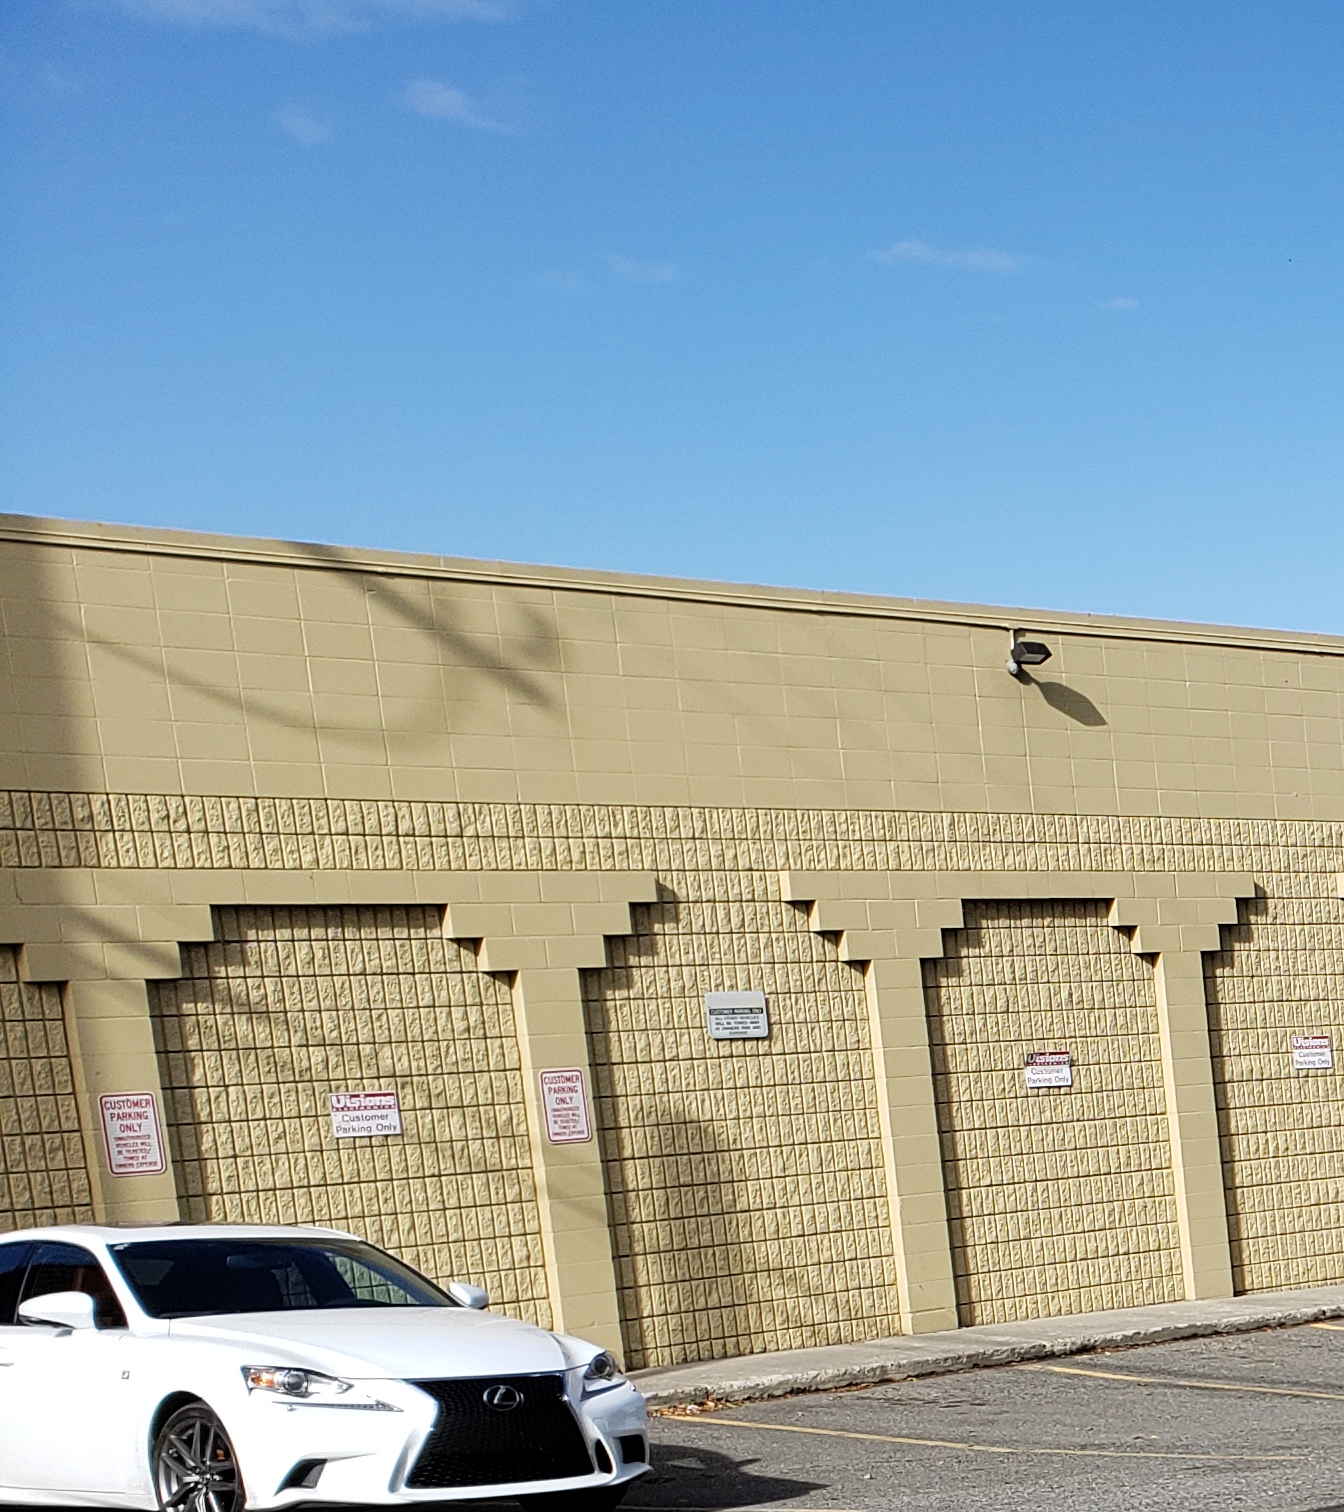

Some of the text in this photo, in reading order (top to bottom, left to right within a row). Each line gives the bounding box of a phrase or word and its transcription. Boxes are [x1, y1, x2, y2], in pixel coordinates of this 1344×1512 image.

[544, 1074, 580, 1085] CUSTOMER
[548, 1086, 578, 1095] PARKING
[104, 1098, 151, 1110] CUSTOMER
[331, 1094, 395, 1108] Visions
[556, 1096, 573, 1105] ONLY
[110, 1111, 149, 1122] PARKING
[342, 1114, 389, 1122] Customer
[120, 1122, 142, 1133] ONLY
[336, 1123, 398, 1134] Parking Only
